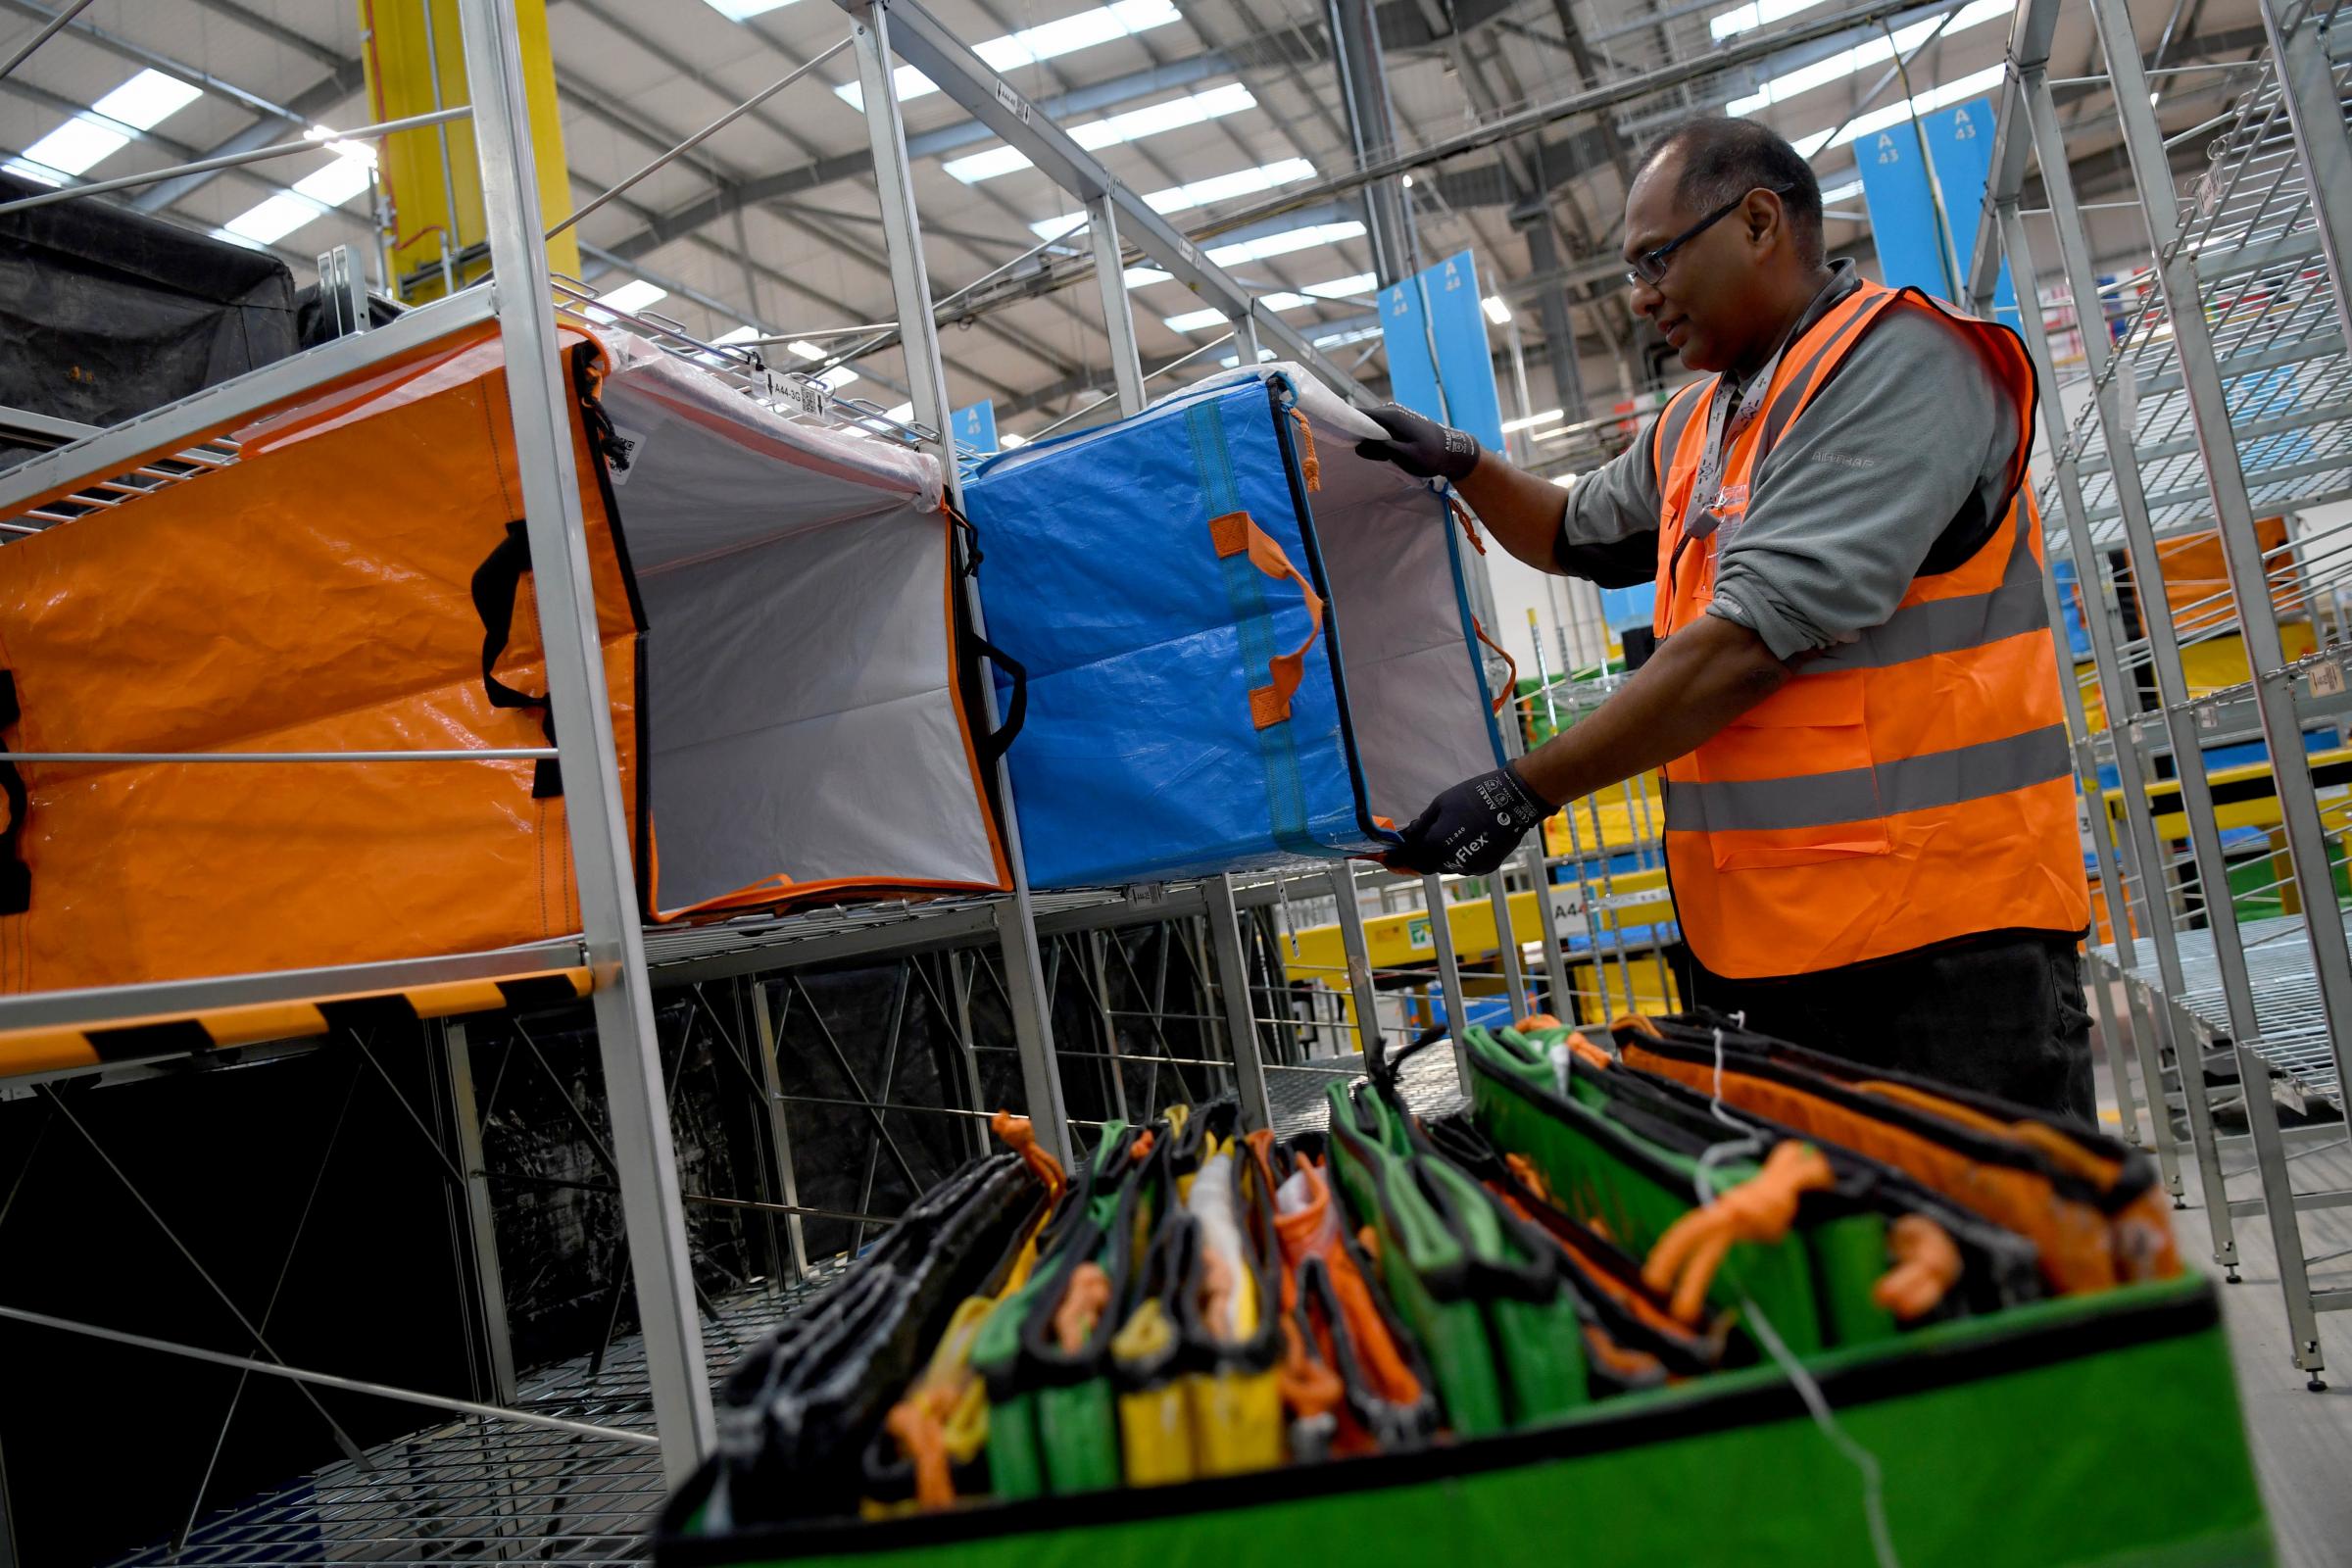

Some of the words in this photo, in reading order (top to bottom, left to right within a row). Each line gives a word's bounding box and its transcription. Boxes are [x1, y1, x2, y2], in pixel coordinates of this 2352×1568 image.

[1954, 109, 1970, 125] A
[1955, 124, 1976, 140] 43
[1879, 133, 1893, 150] A
[1879, 149, 1899, 165] 43
[1446, 262, 1456, 277] A
[1394, 287, 1404, 303] A
[774, 383, 801, 402] A44-3G
[968, 409, 978, 421] A
[1476, 785, 1496, 810] Ansell
